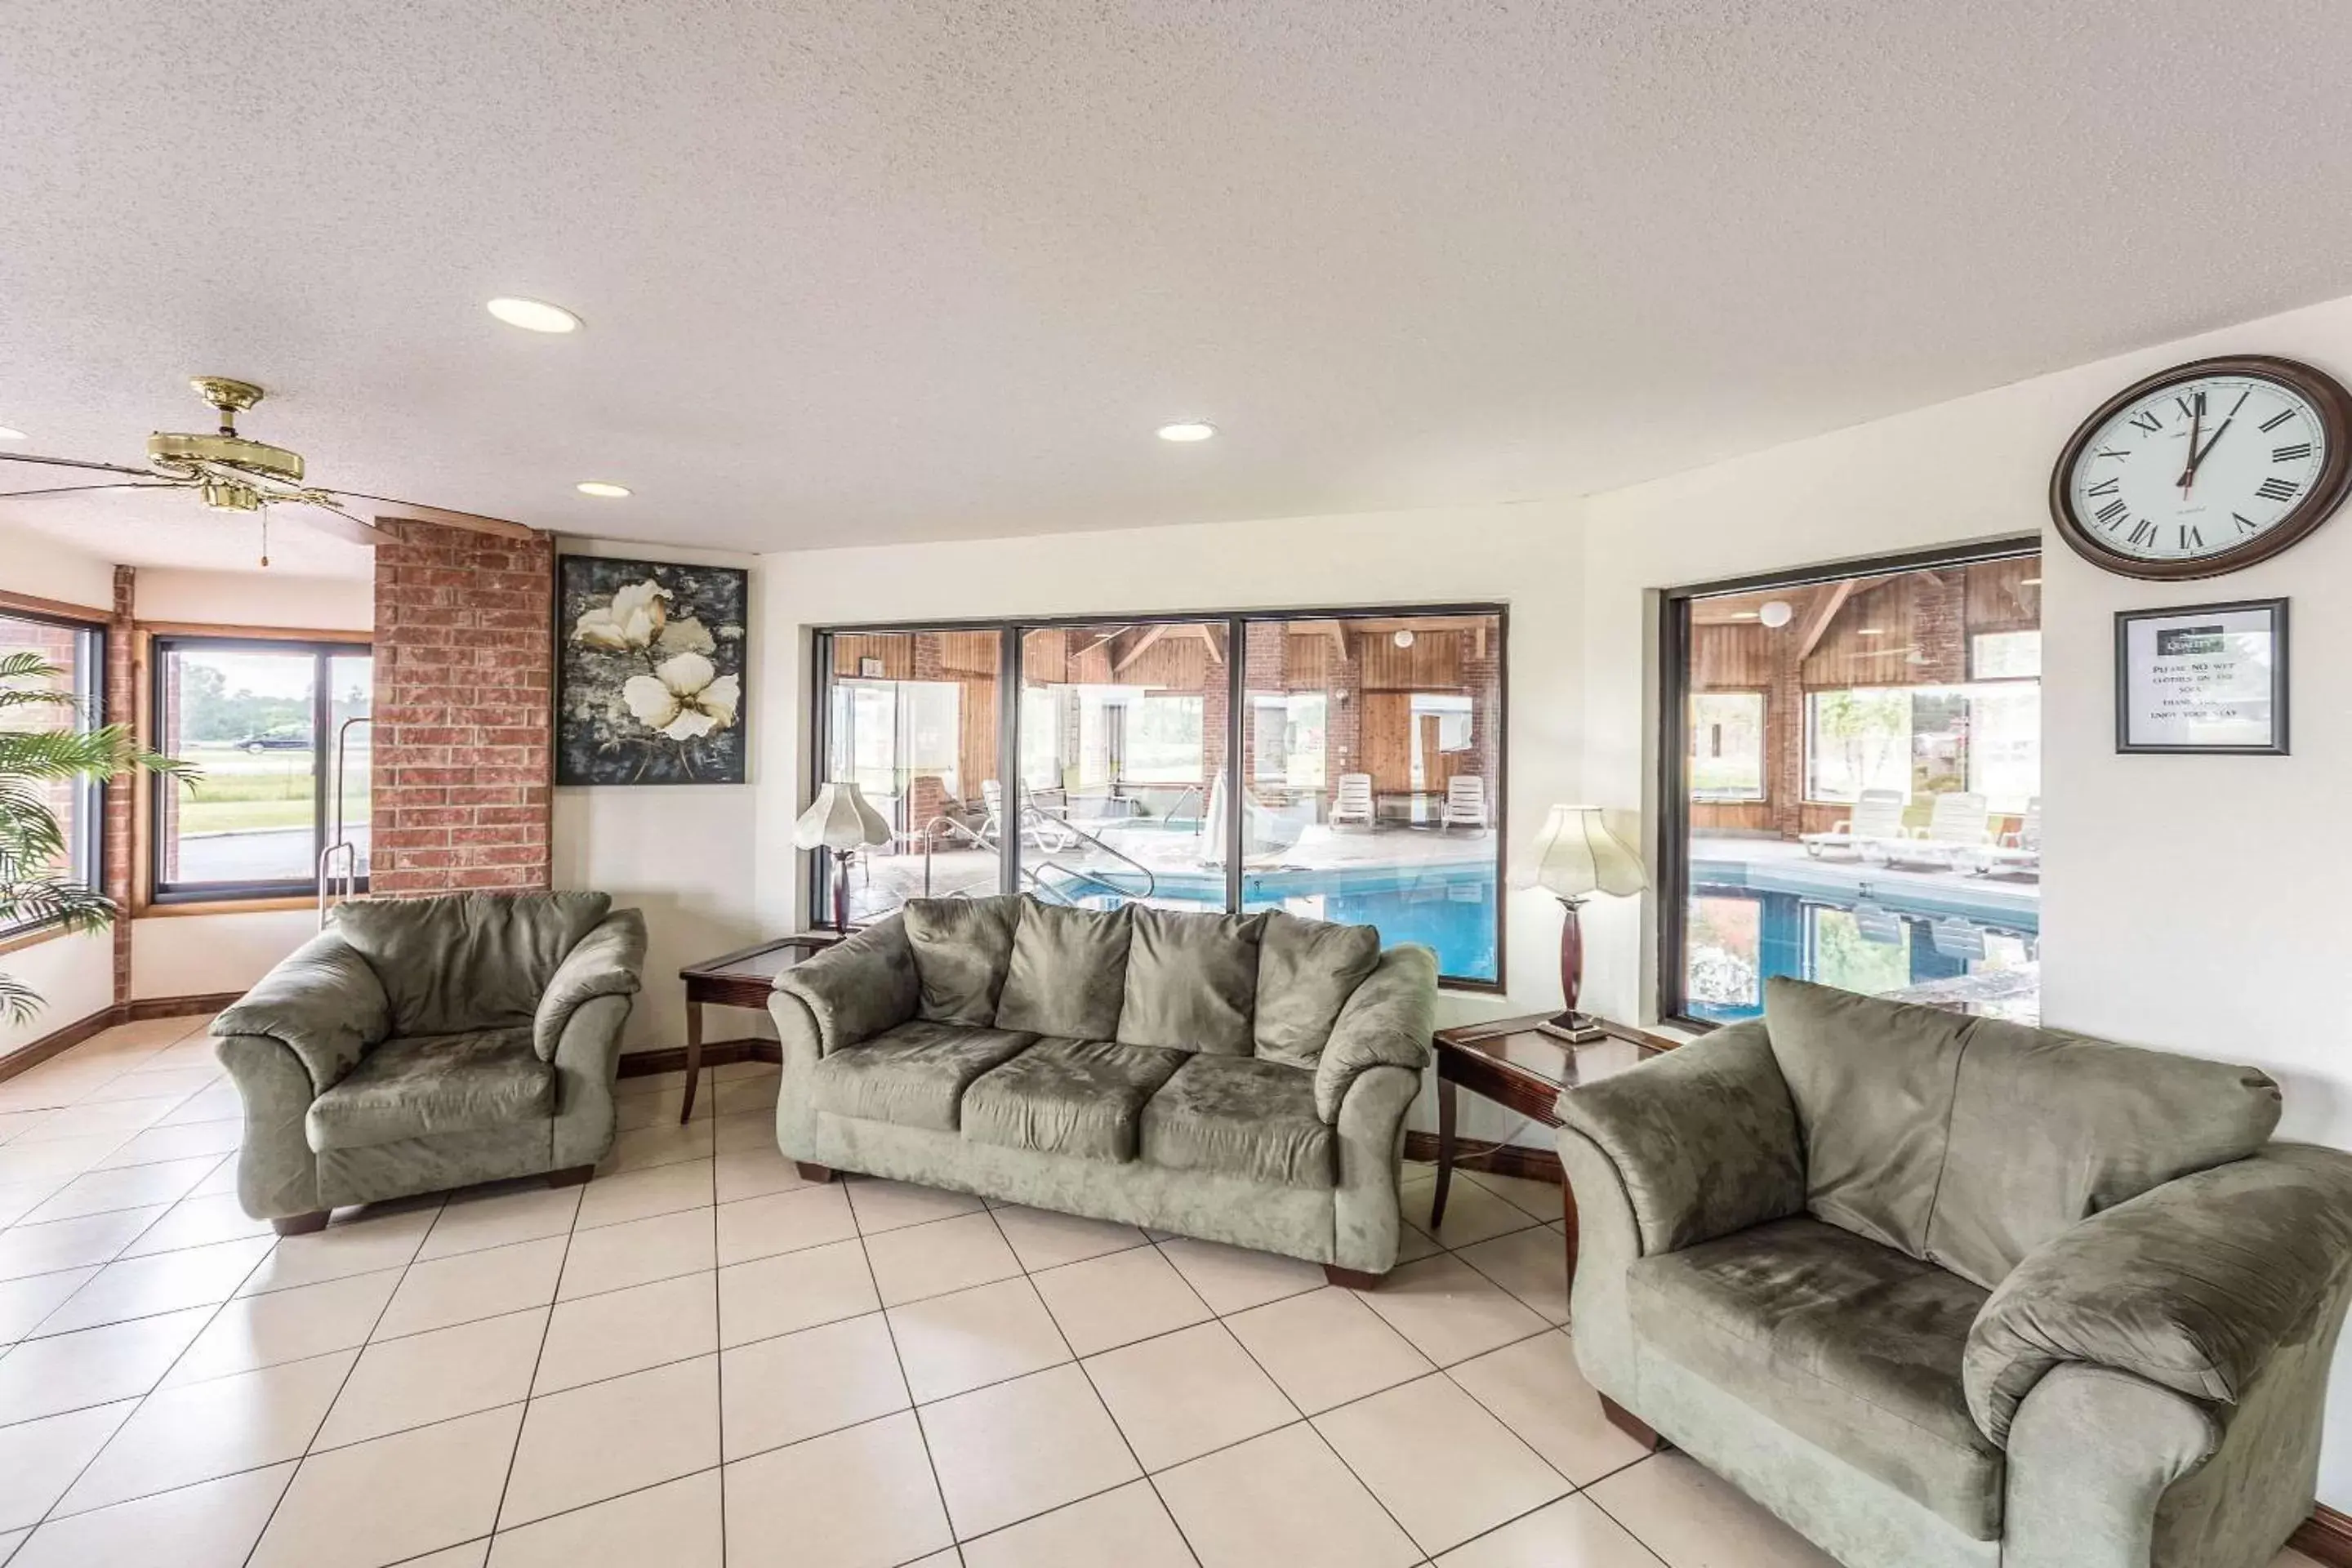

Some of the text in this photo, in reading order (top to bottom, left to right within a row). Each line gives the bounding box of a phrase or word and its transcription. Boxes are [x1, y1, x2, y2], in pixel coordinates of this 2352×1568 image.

[2129, 411, 2163, 438] XI
[2258, 408, 2296, 433] II
[2098, 446, 2131, 463] X
[2272, 443, 2311, 463] III
[2088, 477, 2119, 498] IX
[2094, 498, 2131, 532] VIII
[2232, 512, 2256, 533] V
[2127, 519, 2158, 547] VII
[2179, 524, 2203, 549] VI
